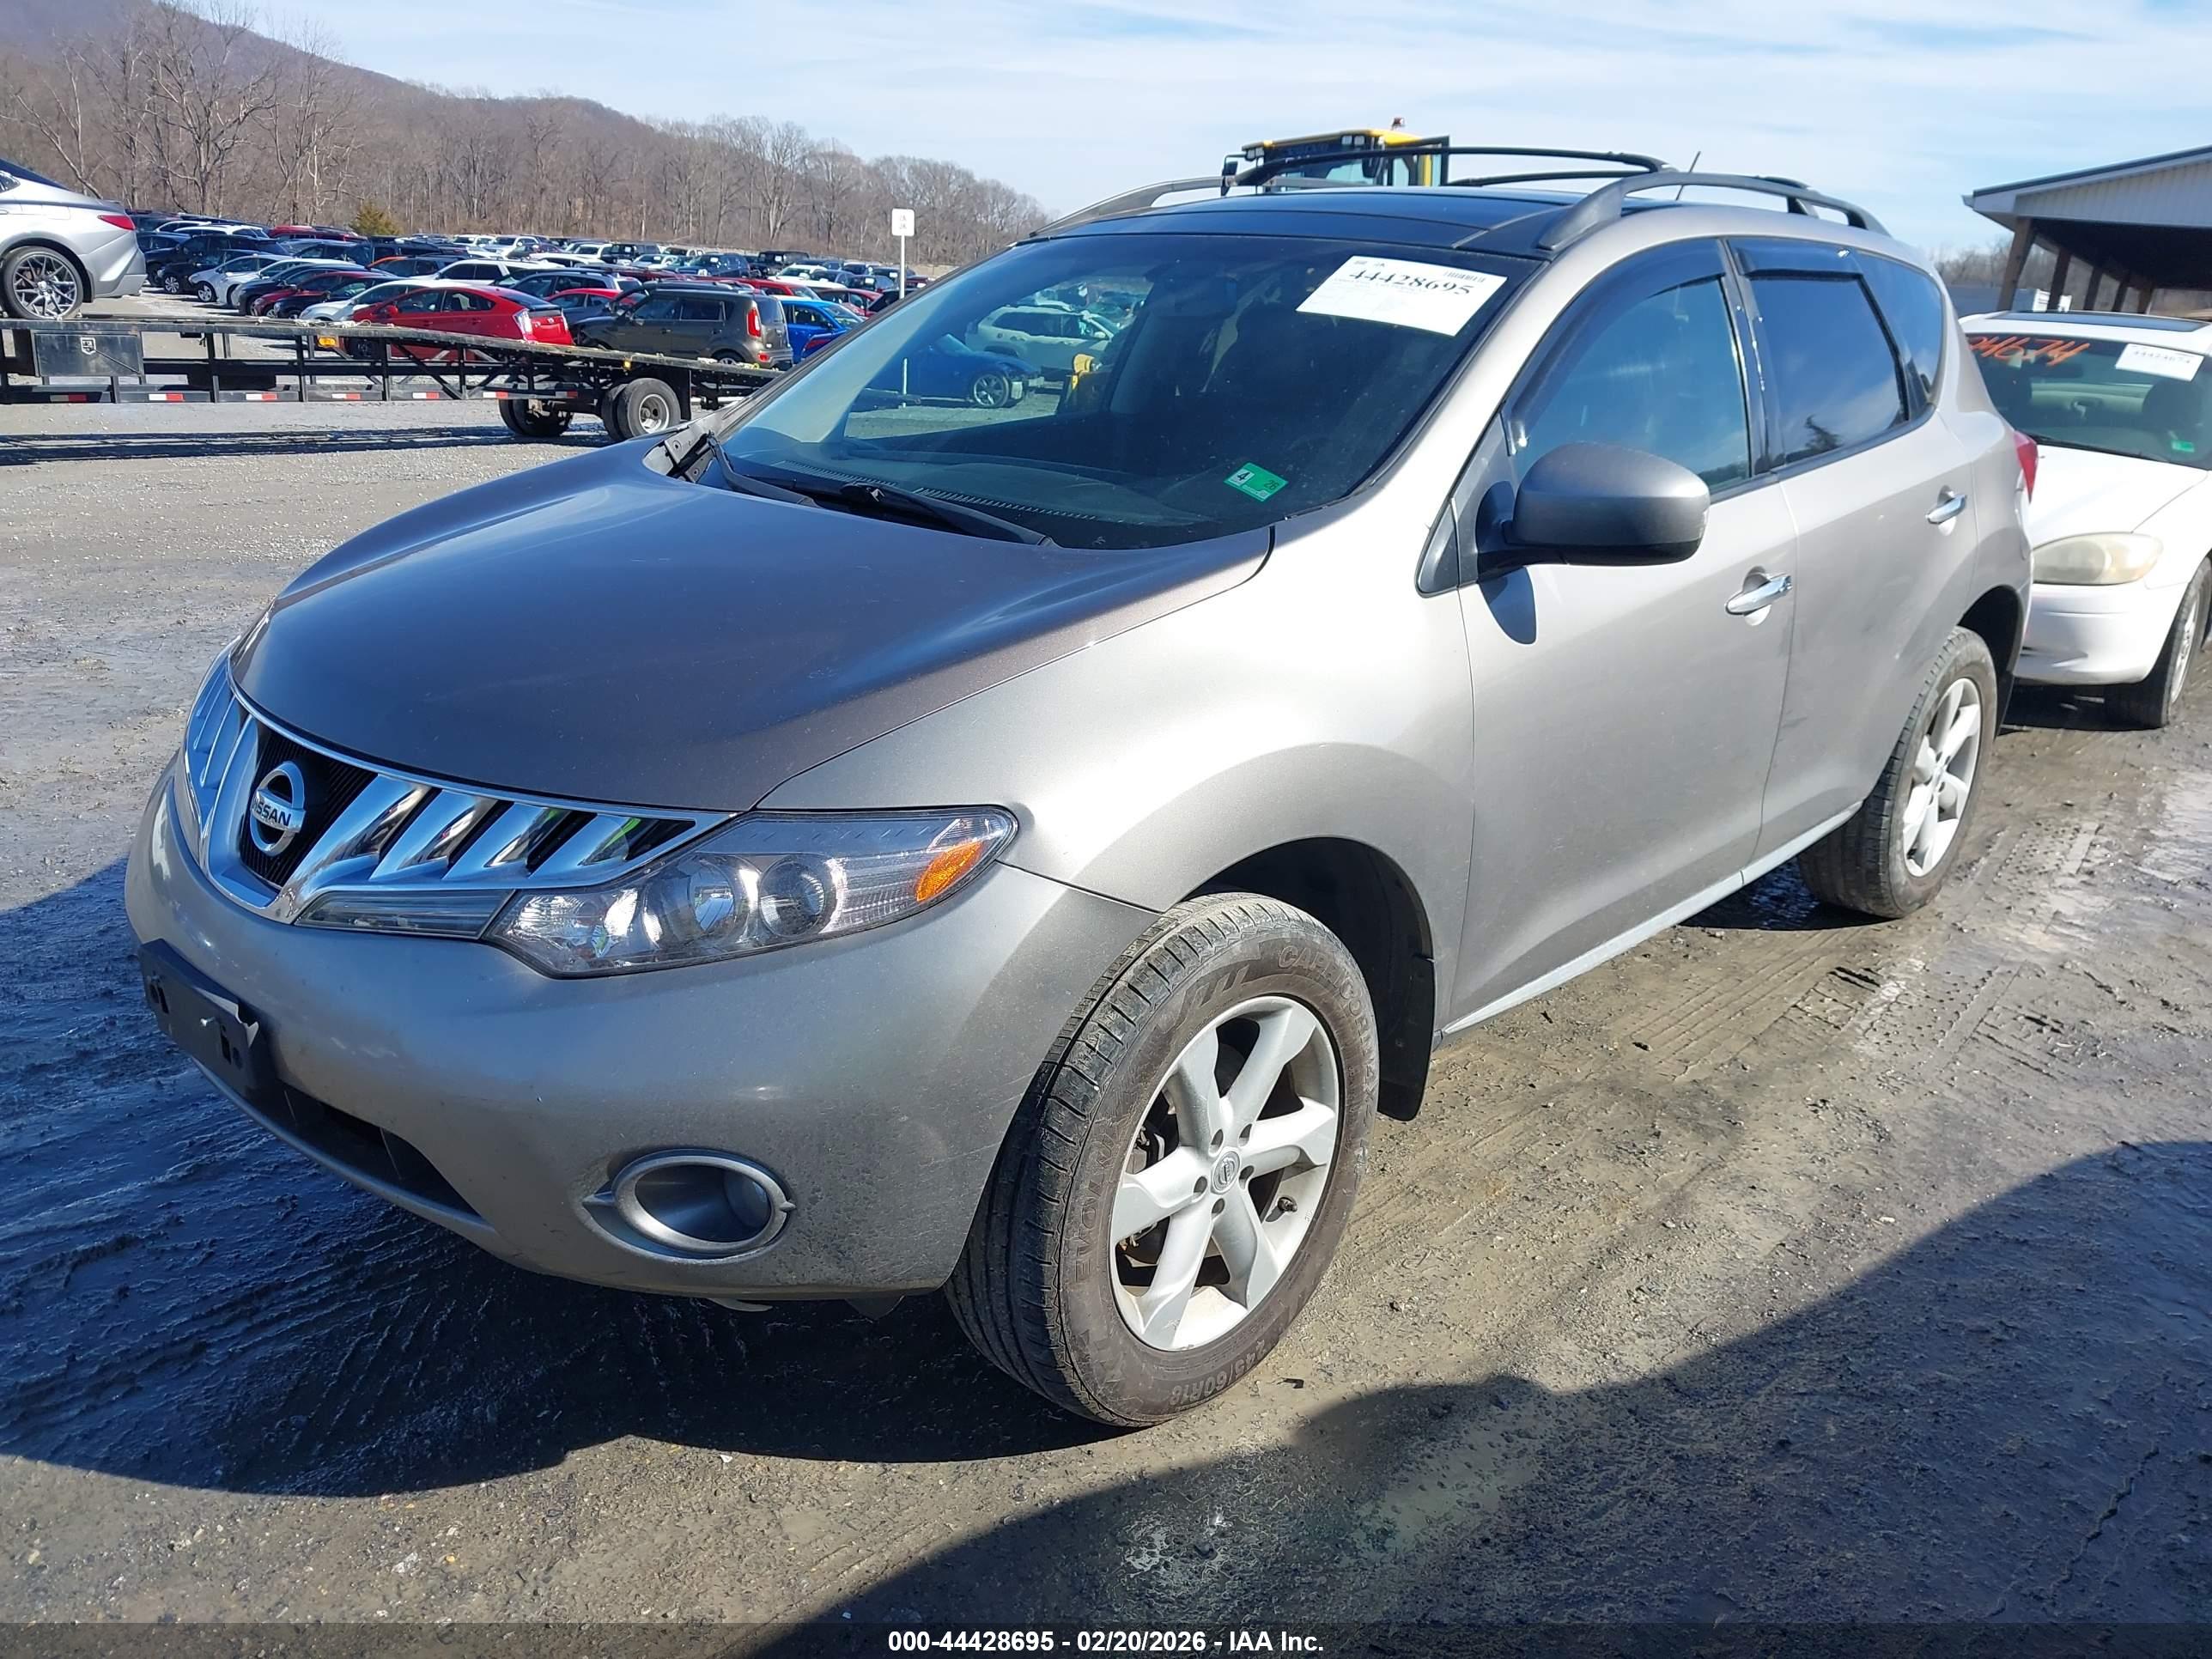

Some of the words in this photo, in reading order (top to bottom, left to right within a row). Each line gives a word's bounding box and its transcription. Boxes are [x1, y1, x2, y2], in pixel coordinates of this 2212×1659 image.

[1349, 270, 1475, 295] 44428695
[1237, 471, 1251, 482] 4
[251, 795, 292, 827] NISSAN
[1170, 1340, 1267, 1406] 245/60R18
